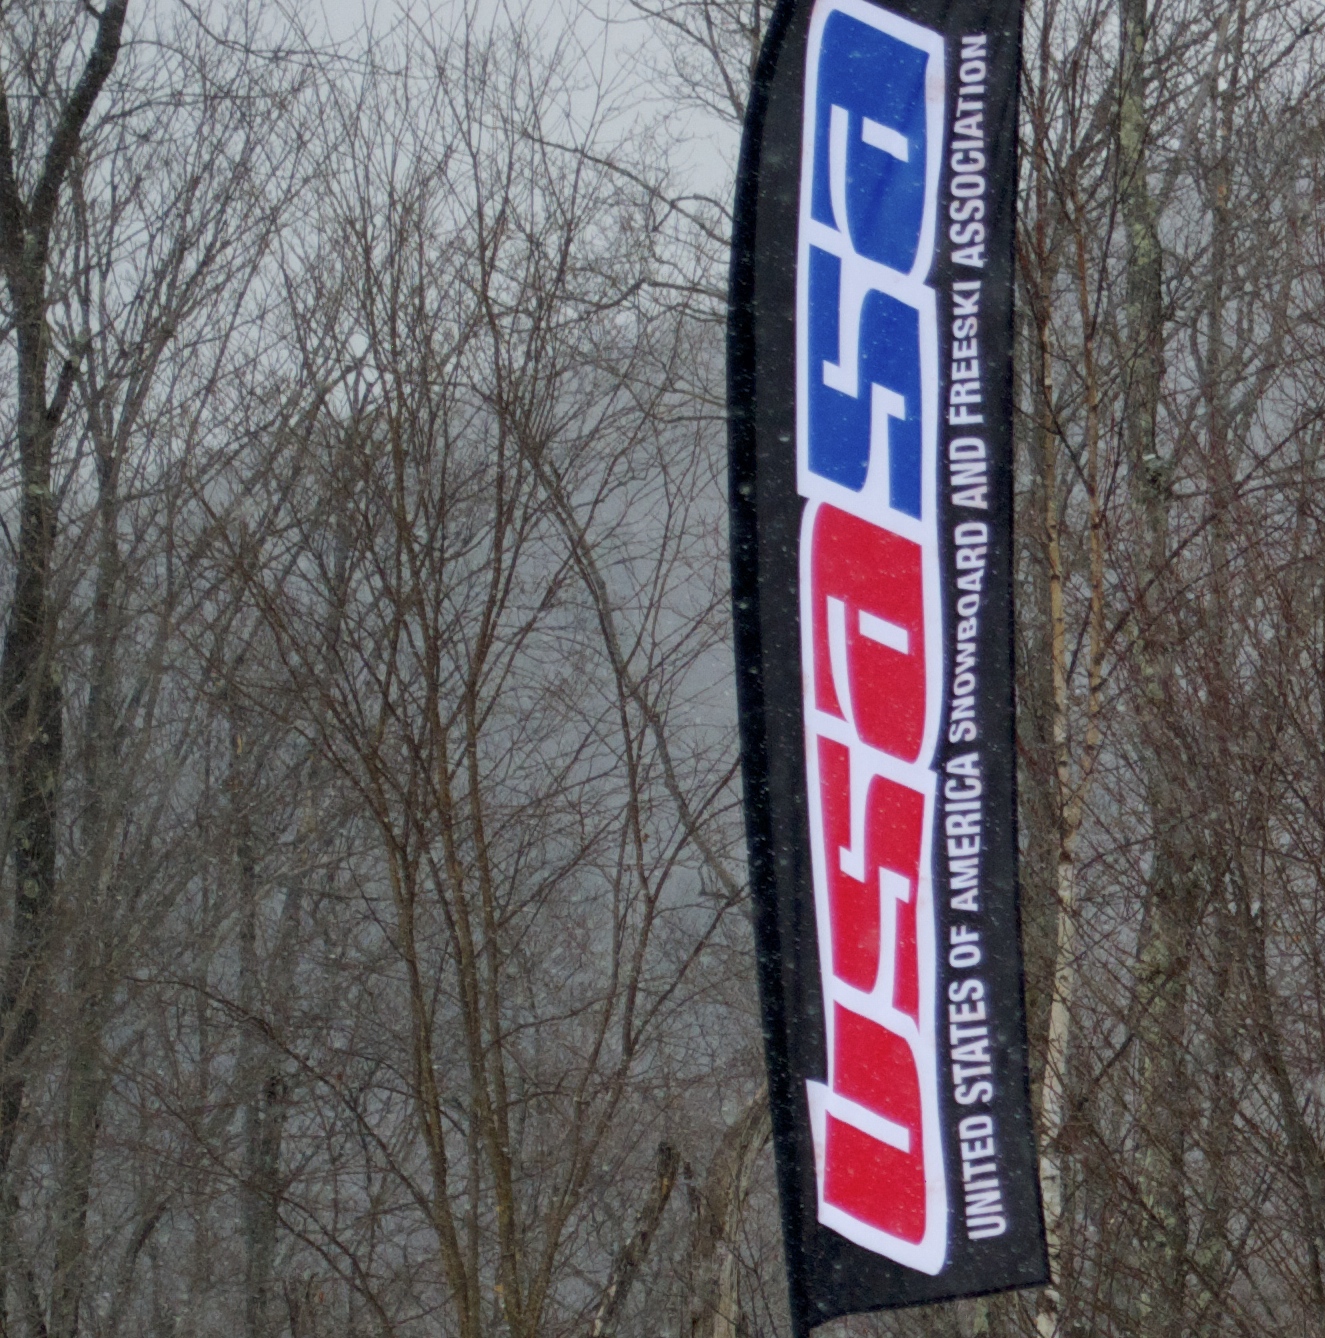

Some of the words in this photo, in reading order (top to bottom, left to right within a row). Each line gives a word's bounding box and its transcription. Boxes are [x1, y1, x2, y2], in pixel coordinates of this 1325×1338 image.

[949, 34, 987, 269] ASSOCIATION
[947, 280, 983, 427] FREESKI
[949, 437, 988, 511] AND
[948, 520, 988, 744] SNOWBOARD
[944, 751, 982, 913] AMERICA
[948, 924, 982, 968] OF
[948, 978, 993, 1105] STATES
[959, 1115, 1006, 1241] UNITED
